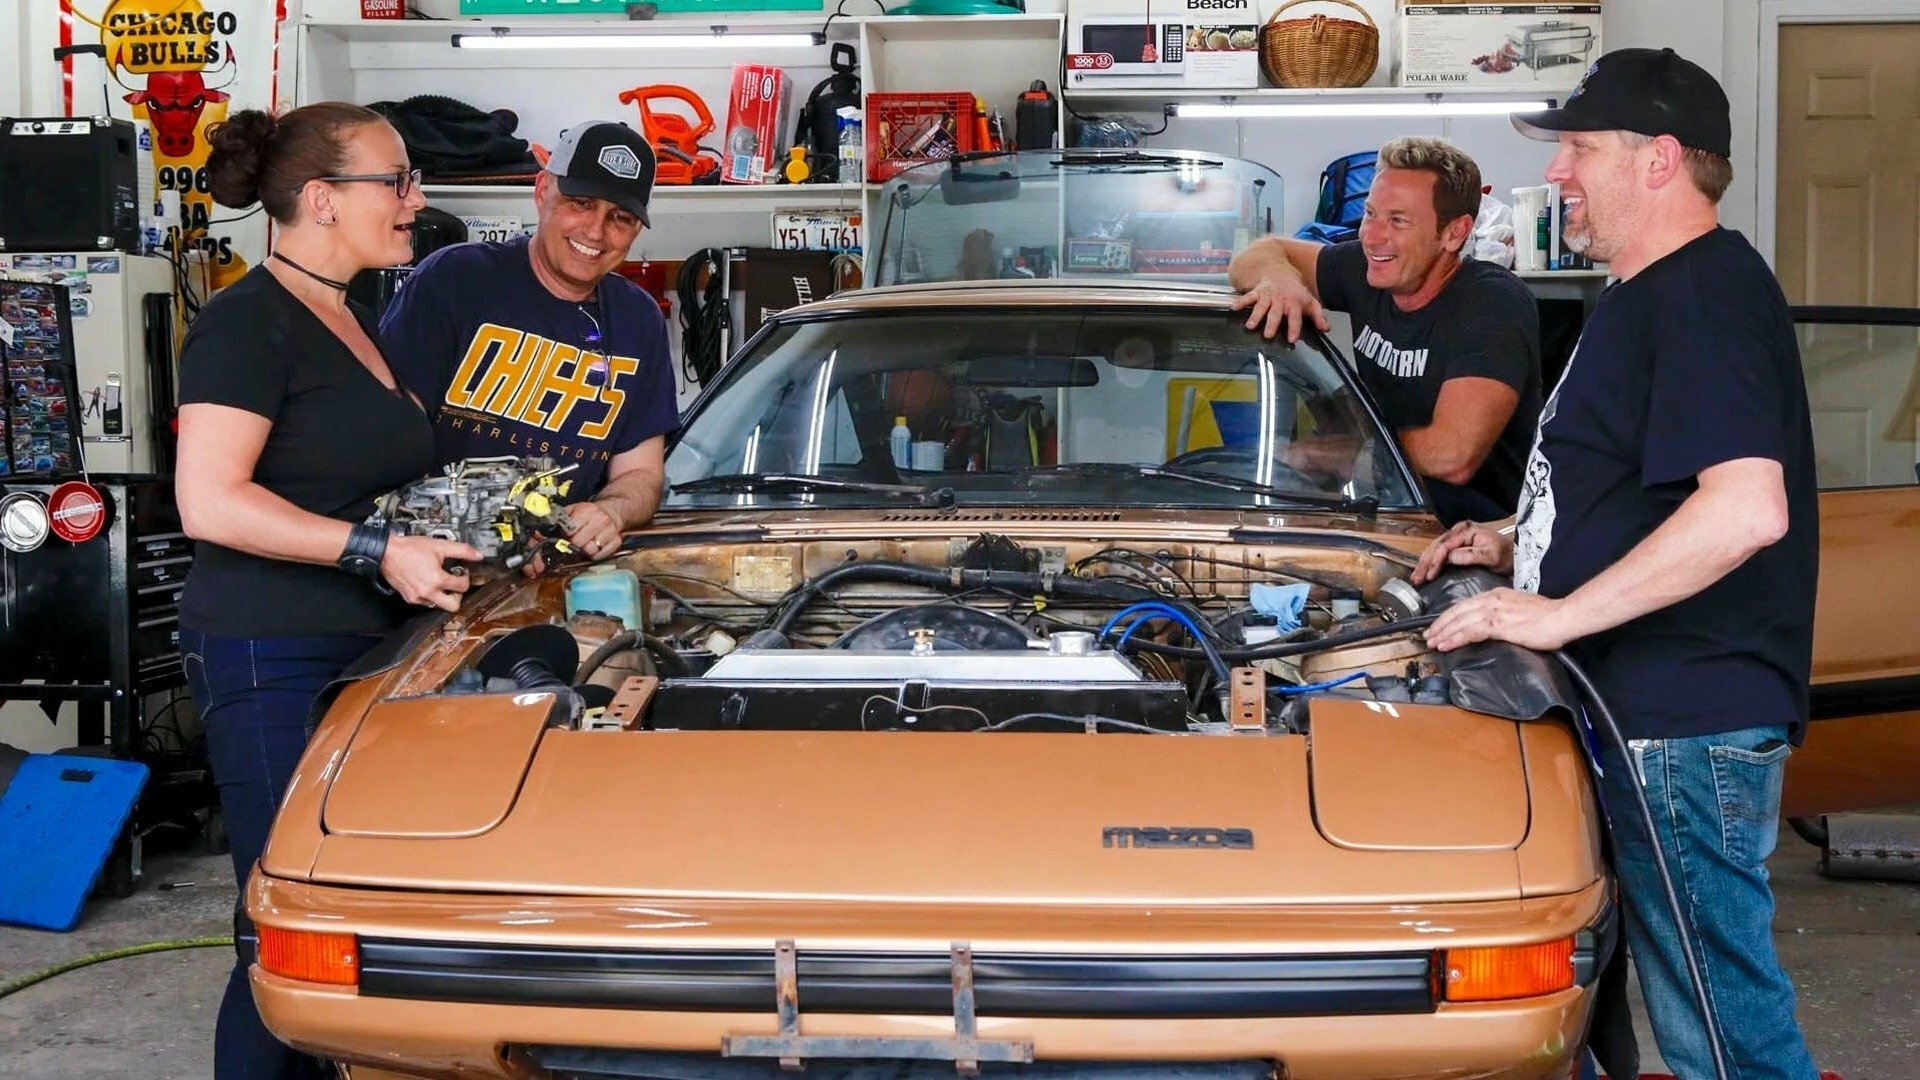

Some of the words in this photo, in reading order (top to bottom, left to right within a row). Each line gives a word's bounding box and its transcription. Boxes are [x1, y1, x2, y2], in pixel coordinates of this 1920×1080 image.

[1187, 0, 1248, 9] Beach
[109, 12, 237, 37] CHICAGO
[130, 41, 219, 66] BULLS
[779, 228, 807, 250] Y51
[821, 228, 858, 250] 4761
[445, 322, 640, 440] CHIEFS
[1102, 826, 1255, 851] mazda
